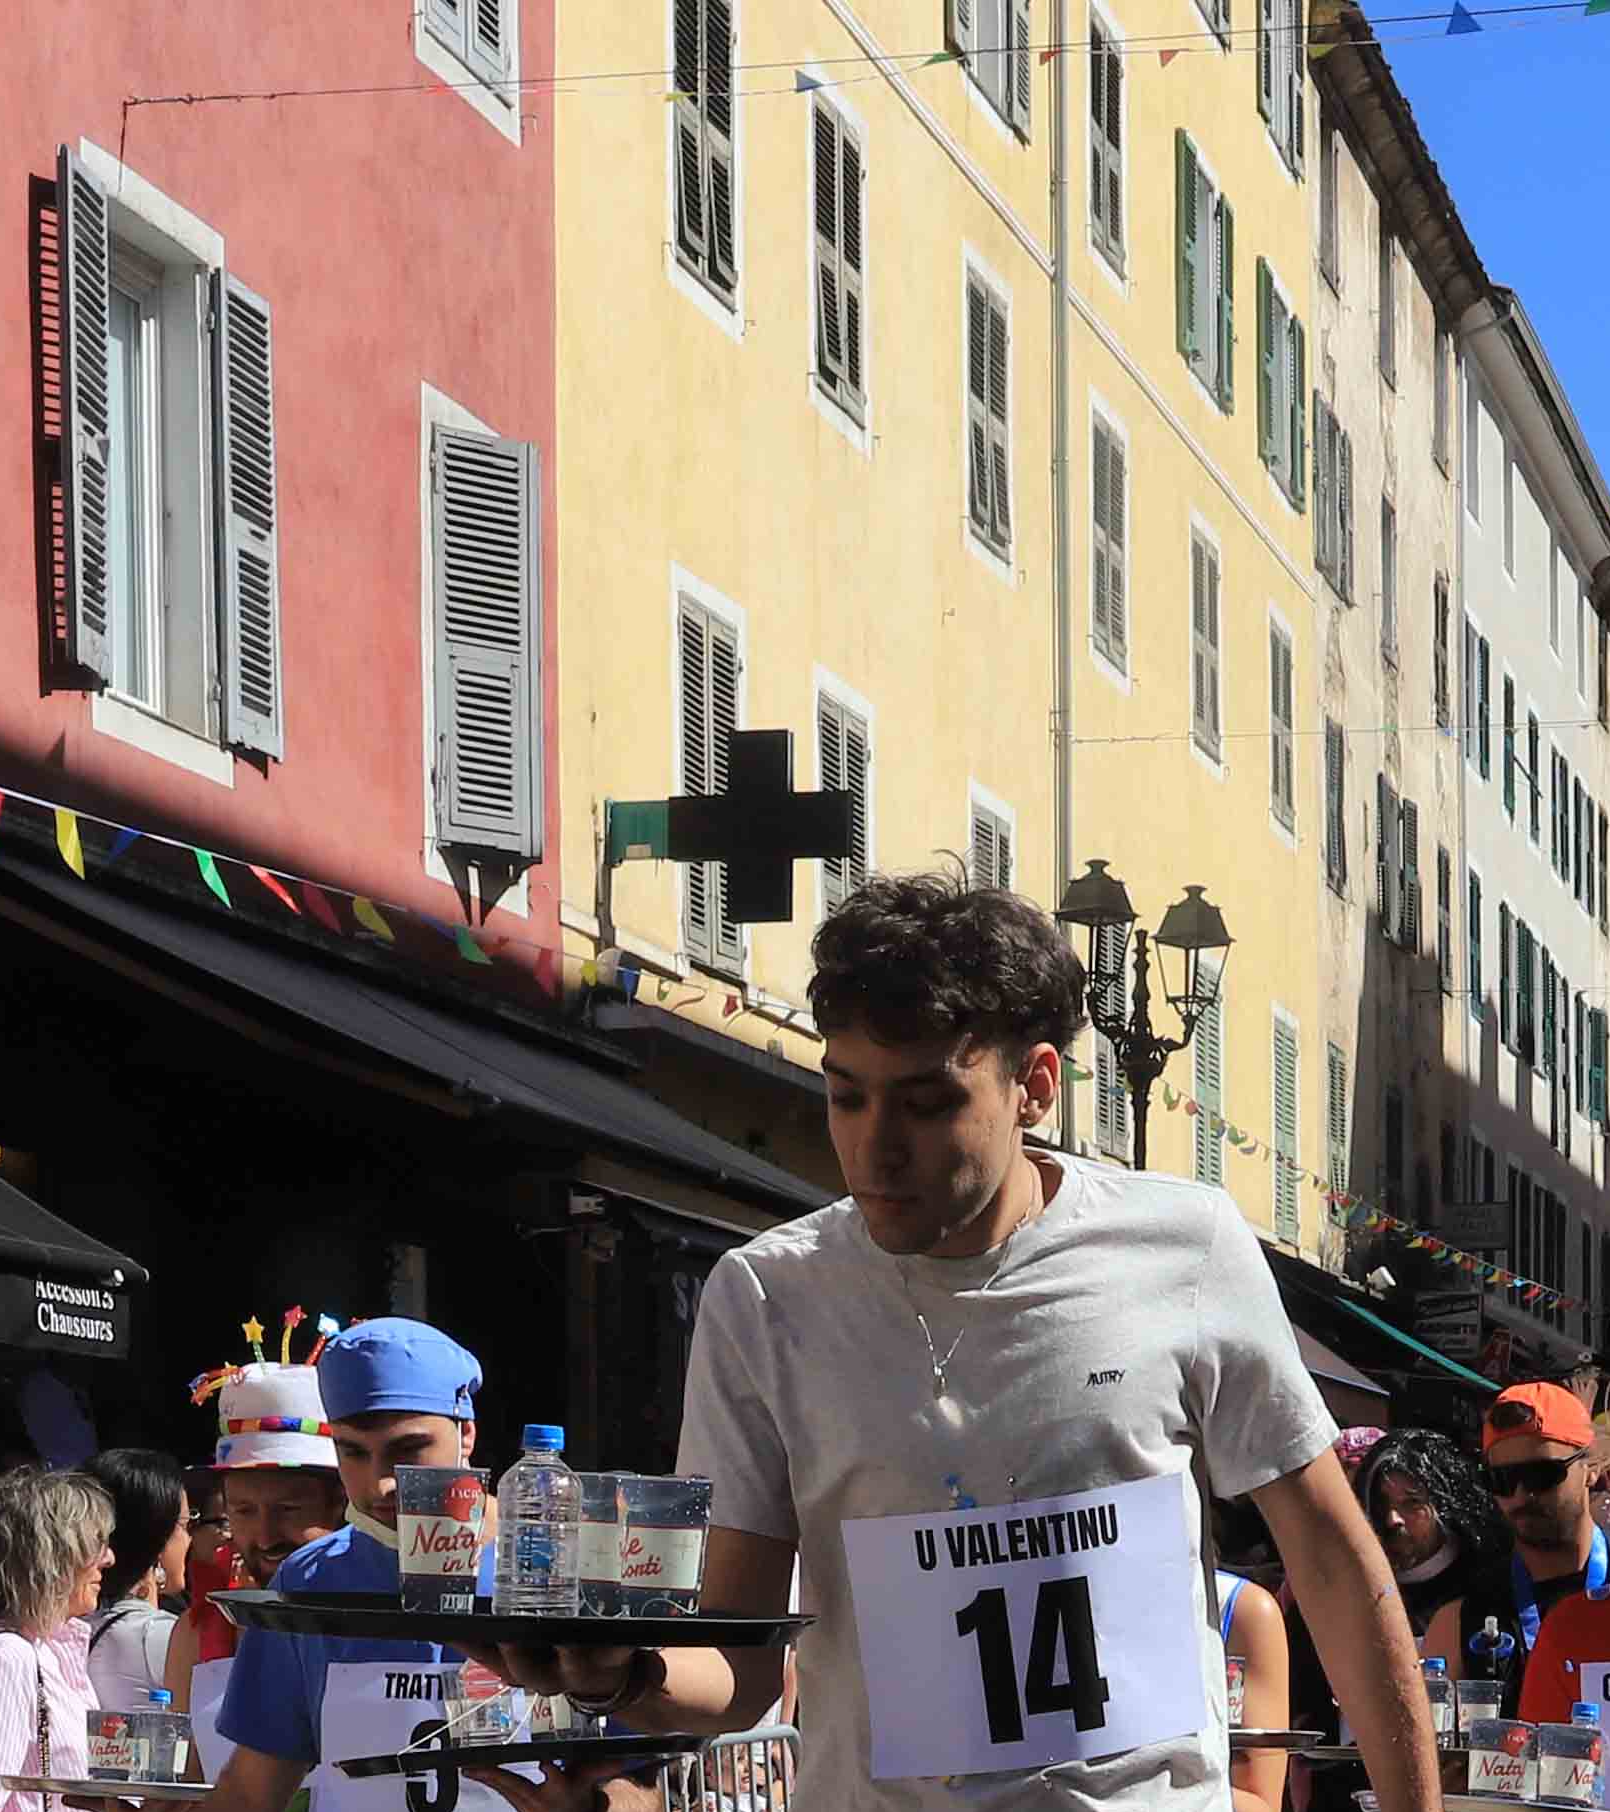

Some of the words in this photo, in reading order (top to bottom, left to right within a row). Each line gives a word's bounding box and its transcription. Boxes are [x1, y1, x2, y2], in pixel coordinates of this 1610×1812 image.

[37, 1302, 115, 1343] Chaussures
[1084, 1369, 1126, 1388] AUTRY
[914, 1528, 938, 1572] U
[945, 1503, 1120, 1569] VALENTINU
[954, 1575, 1111, 1745] 14
